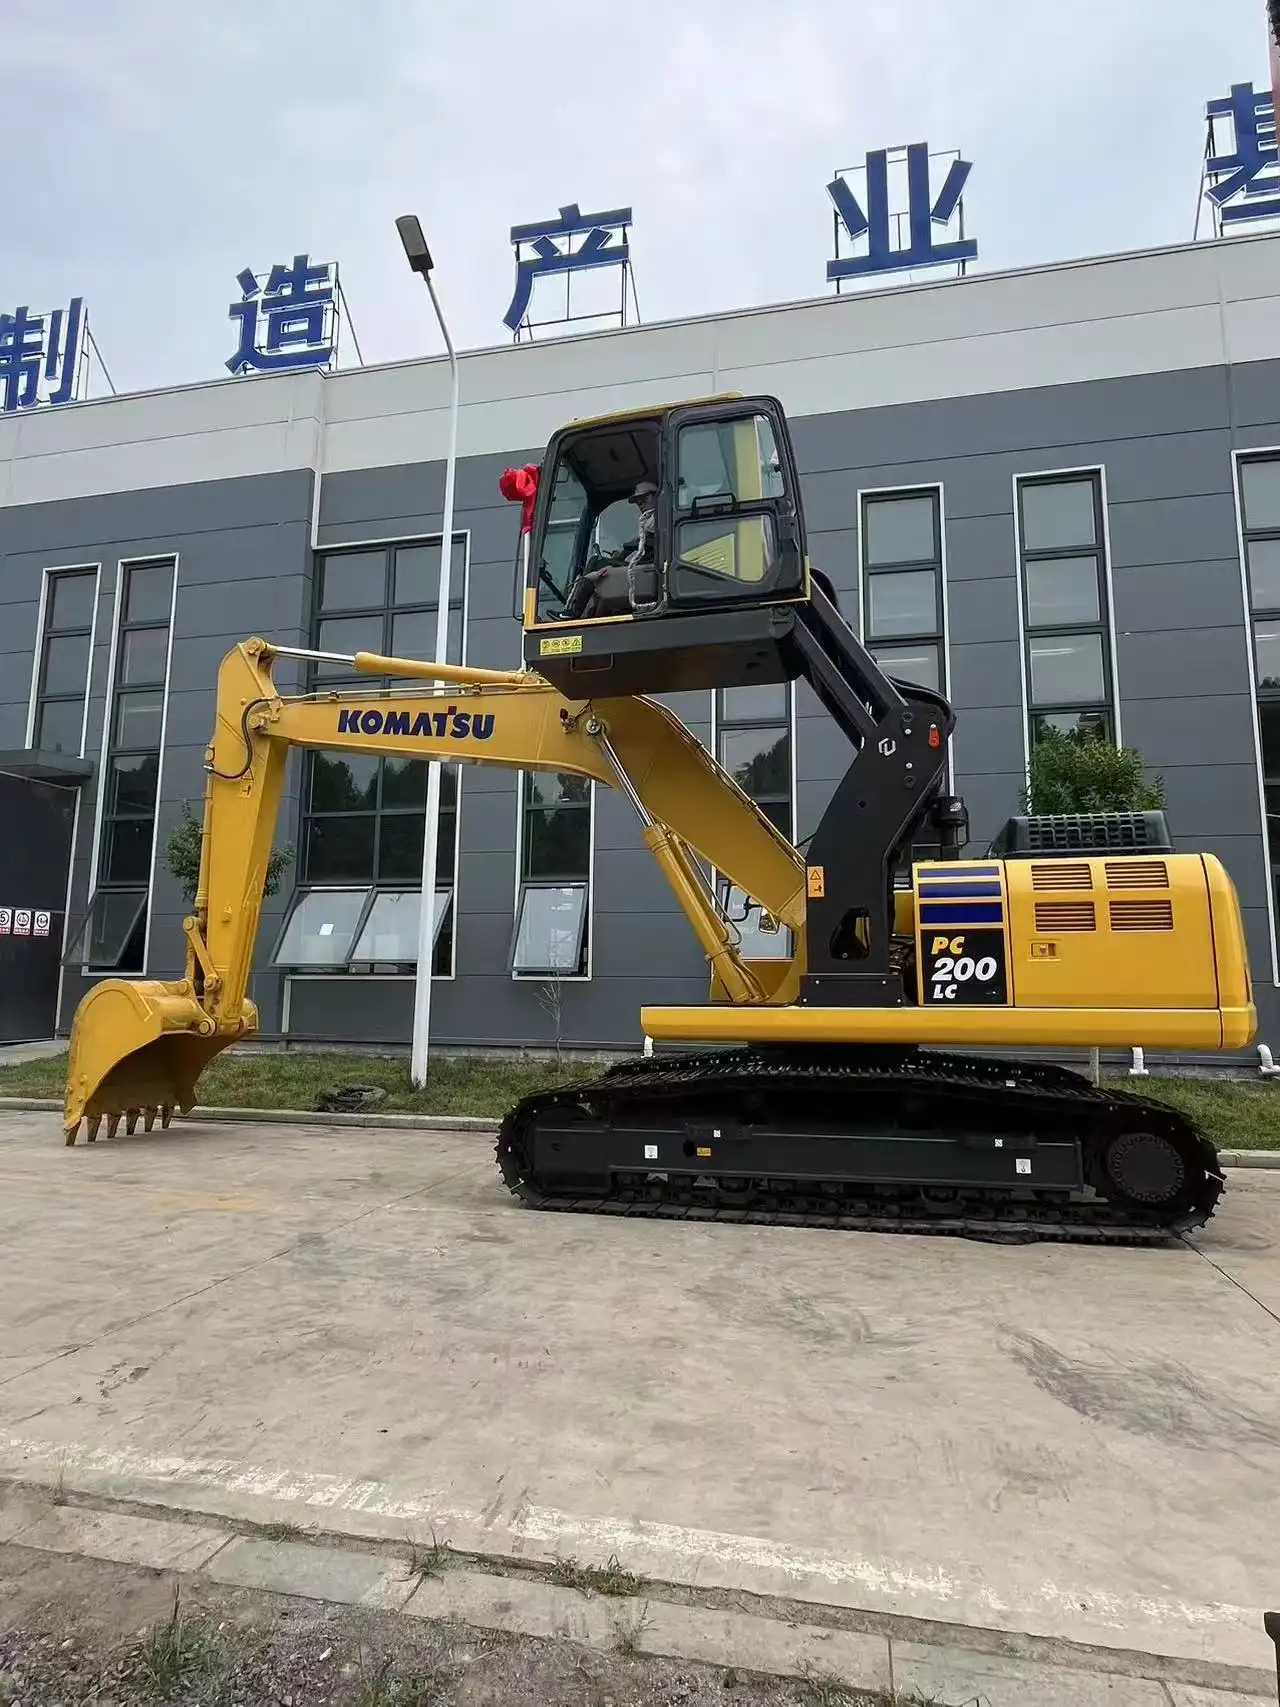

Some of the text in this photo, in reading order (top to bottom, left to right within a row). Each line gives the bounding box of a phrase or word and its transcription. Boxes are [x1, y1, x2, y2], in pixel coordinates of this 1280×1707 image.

[337, 705, 495, 740] KOMATSU
[931, 936, 965, 954] PC
[931, 957, 997, 981] 200
[933, 984, 958, 999] LC
